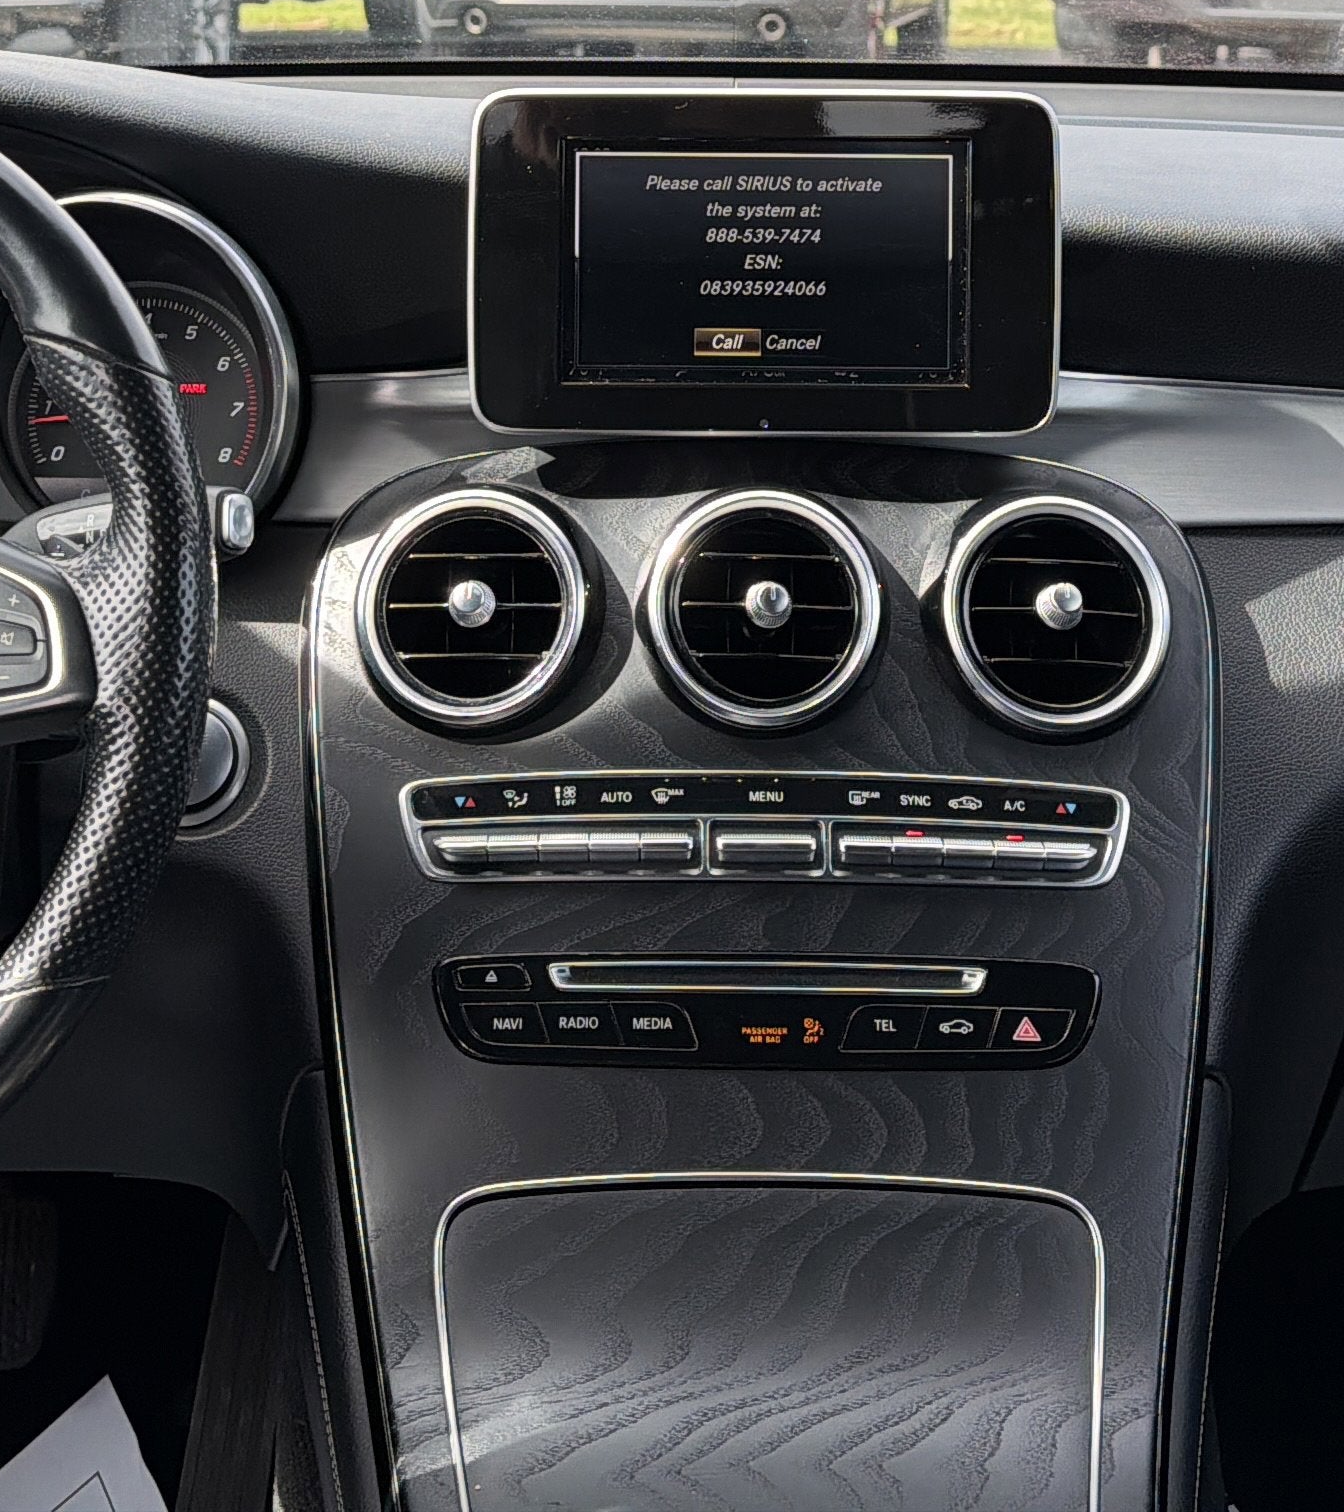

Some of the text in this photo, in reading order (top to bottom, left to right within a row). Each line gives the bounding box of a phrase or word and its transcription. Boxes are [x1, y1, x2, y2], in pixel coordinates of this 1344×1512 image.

[645, 175, 883, 192] Please call SIRIUS to activate
[706, 202, 822, 221] the system at:
[705, 228, 822, 244] 888-539-7474
[743, 254, 783, 270] ESN:
[699, 280, 827, 296] 083935924066
[185, 325, 199, 340] 5
[711, 333, 744, 351] Call
[765, 334, 821, 352] Cancel
[216, 356, 231, 371] 6
[179, 383, 208, 395] PARK
[230, 401, 245, 417] 7
[50, 445, 65, 462] 0
[218, 447, 233, 463] 8
[600, 790, 633, 804] AUTO
[667, 788, 685, 797] MAX
[748, 790, 784, 803] MENU
[861, 791, 881, 799] REAR
[561, 798, 577, 807] OFF
[899, 794, 932, 807] SYNC
[1003, 800, 1026, 812] A/C
[492, 1017, 523, 1030] NAVI
[558, 1016, 599, 1030] RADIO
[632, 1017, 674, 1030] MEDIA
[873, 1018, 897, 1032] TEL
[741, 1026, 788, 1035] PASSENGER
[749, 1035, 781, 1044] AIR BAG
[803, 1036, 819, 1044] OFF
